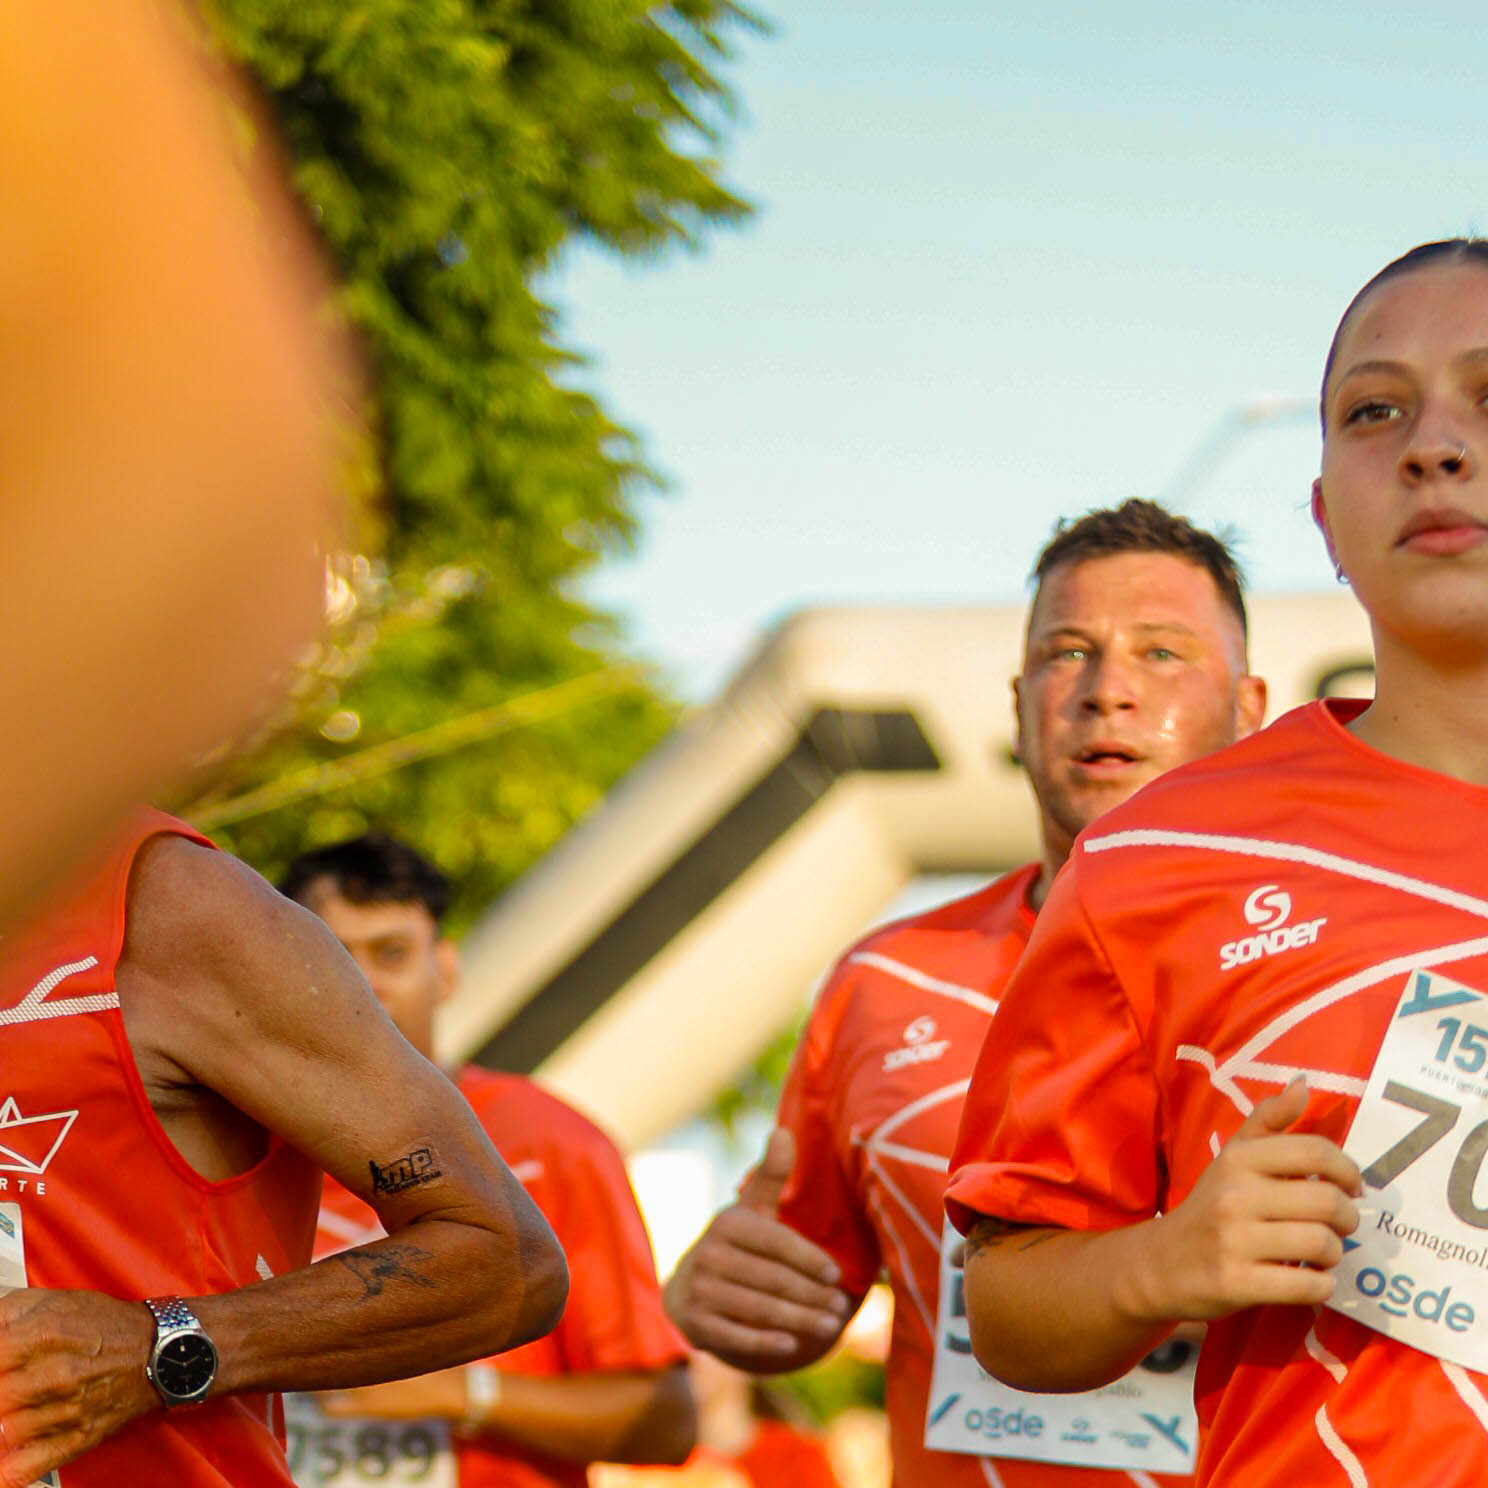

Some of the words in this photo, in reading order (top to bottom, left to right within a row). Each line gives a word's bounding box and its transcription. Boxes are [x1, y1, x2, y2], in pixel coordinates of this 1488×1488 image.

[1355, 1266, 1476, 1333] osde
[964, 1407, 1044, 1440] osde
[286, 1424, 437, 1484] 7589
